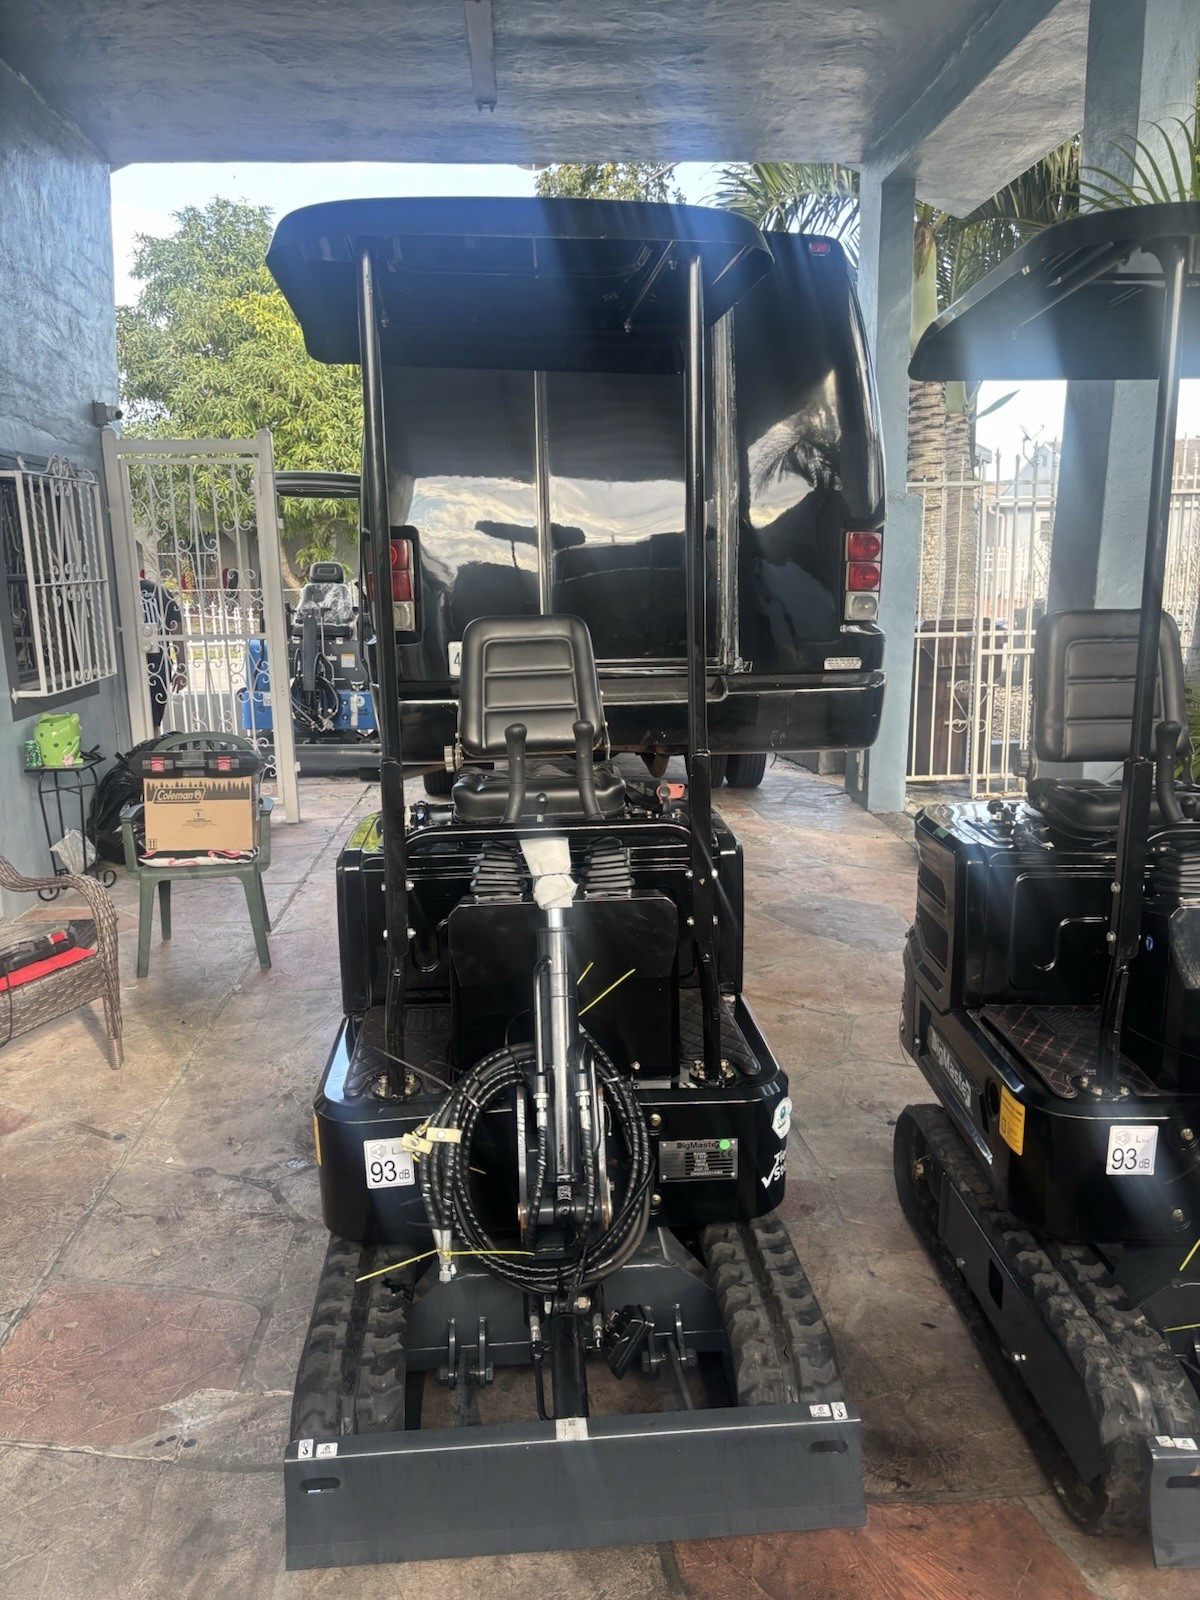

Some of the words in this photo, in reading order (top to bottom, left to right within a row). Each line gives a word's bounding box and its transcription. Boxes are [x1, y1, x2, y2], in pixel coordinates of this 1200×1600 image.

[156, 789, 194, 801] Coleman
[1111, 1147, 1137, 1170] 93
[1138, 1158, 1150, 1169] dB
[370, 1160, 397, 1183] 93
[399, 1168, 411, 1180] dB
